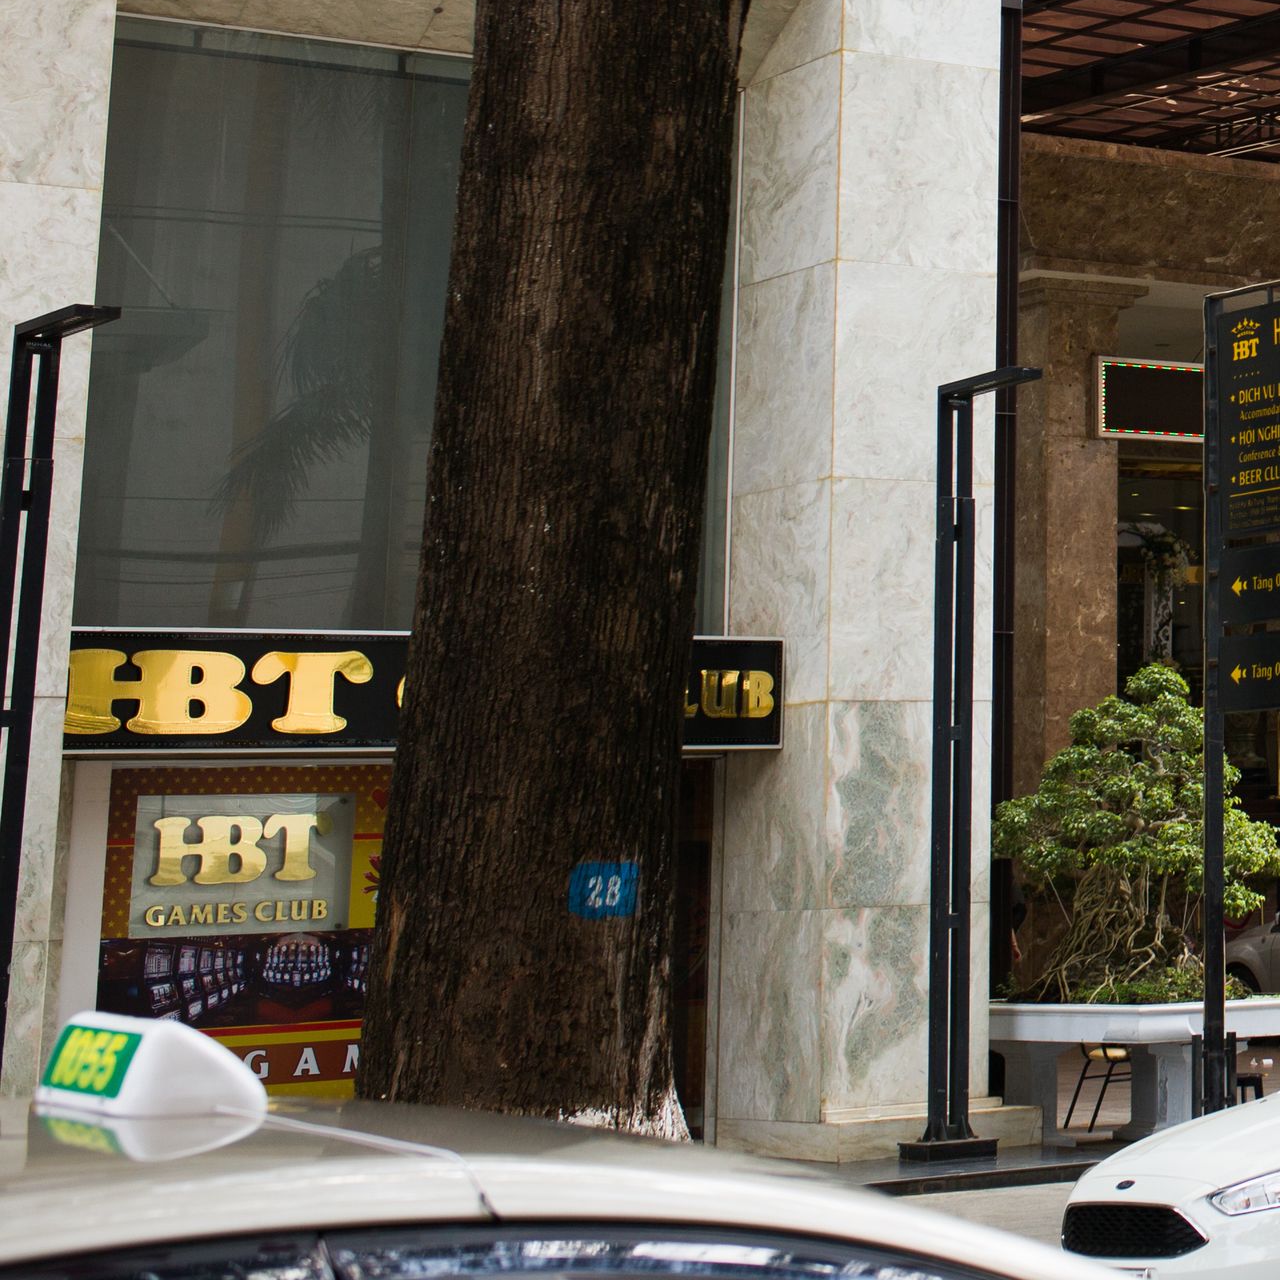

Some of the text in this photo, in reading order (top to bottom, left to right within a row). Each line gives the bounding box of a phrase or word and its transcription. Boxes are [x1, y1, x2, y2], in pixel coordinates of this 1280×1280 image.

[1232, 338, 1259, 361] HBT
[1239, 448, 1276, 463] Conference
[1239, 468, 1262, 486] BEER
[64, 649, 374, 735] HBT
[149, 812, 334, 887] HBT
[585, 875, 621, 908] 28
[145, 898, 329, 927] GAMES CLUB
[51, 1027, 129, 1093] 1055
